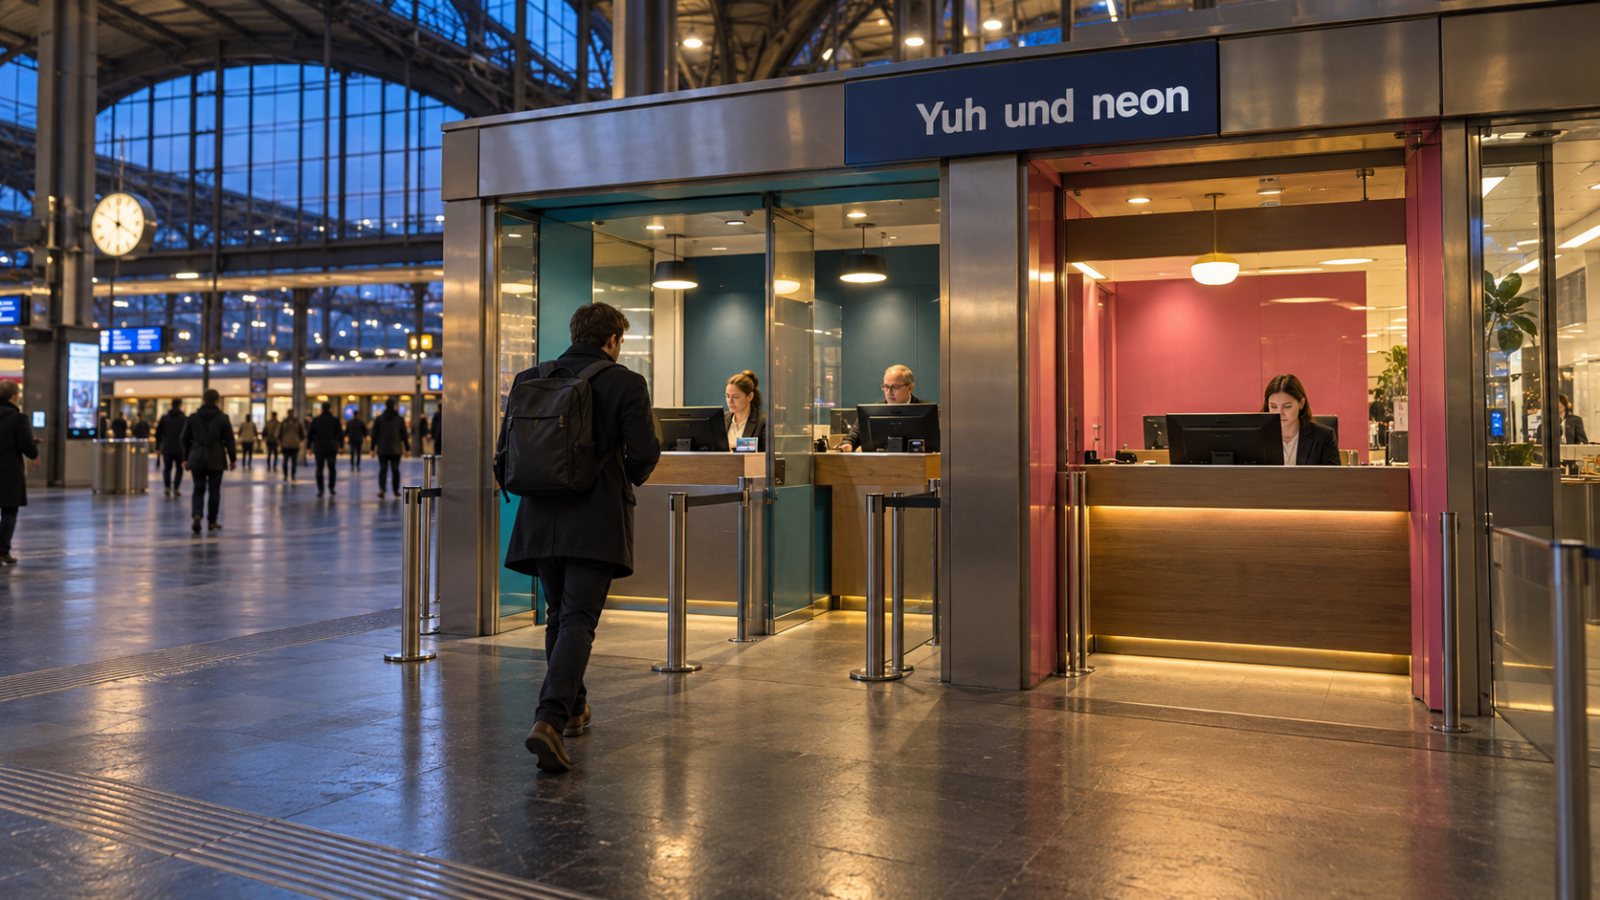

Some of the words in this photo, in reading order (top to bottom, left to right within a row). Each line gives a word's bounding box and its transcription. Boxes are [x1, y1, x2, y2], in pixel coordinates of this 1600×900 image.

[916, 98, 987, 136] Yuh
[1004, 88, 1074, 128] und
[1092, 85, 1190, 120] neon
